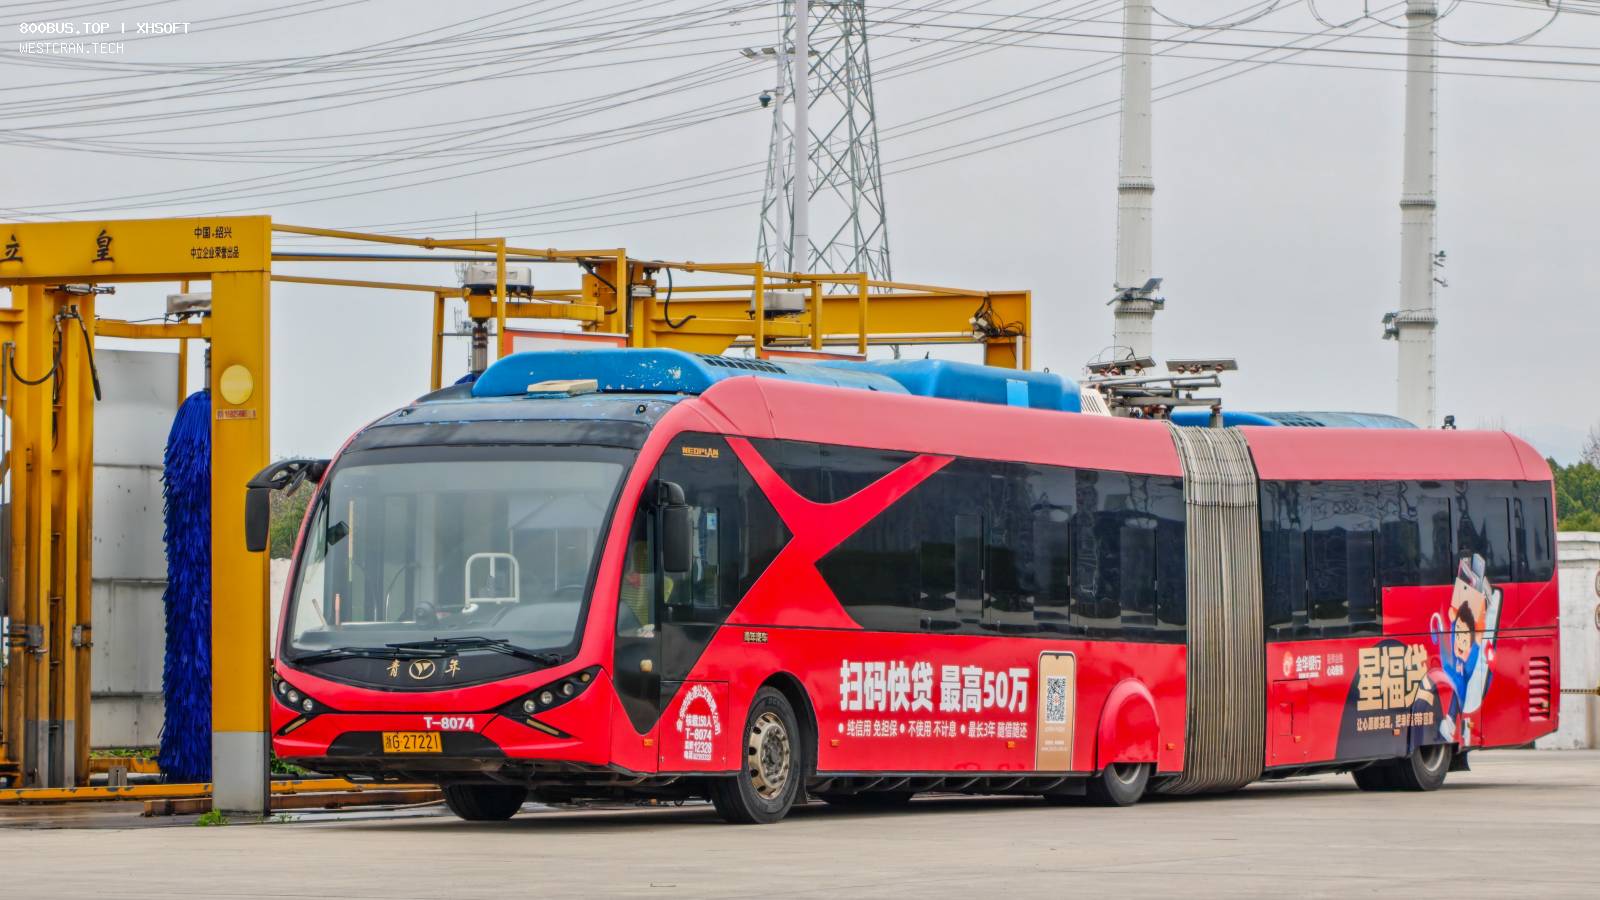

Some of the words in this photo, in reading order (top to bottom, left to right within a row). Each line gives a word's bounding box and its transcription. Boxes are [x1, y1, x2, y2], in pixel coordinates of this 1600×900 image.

[91, 229, 115, 263] 皇
[1295, 655, 1322, 672] 金华银行
[840, 659, 933, 712] 扫码快贷
[939, 665, 1030, 713] 最高50万
[423, 716, 474, 730] T-8074
[846, 720, 871, 736] 纯信用
[873, 720, 898, 737] 免担保
[908, 721, 932, 737] 不使用
[934, 721, 957, 737] 不计息
[968, 722, 996, 738] 最长3年
[997, 722, 1028, 738] 随借随还
[685, 728, 712, 741] T-8074
